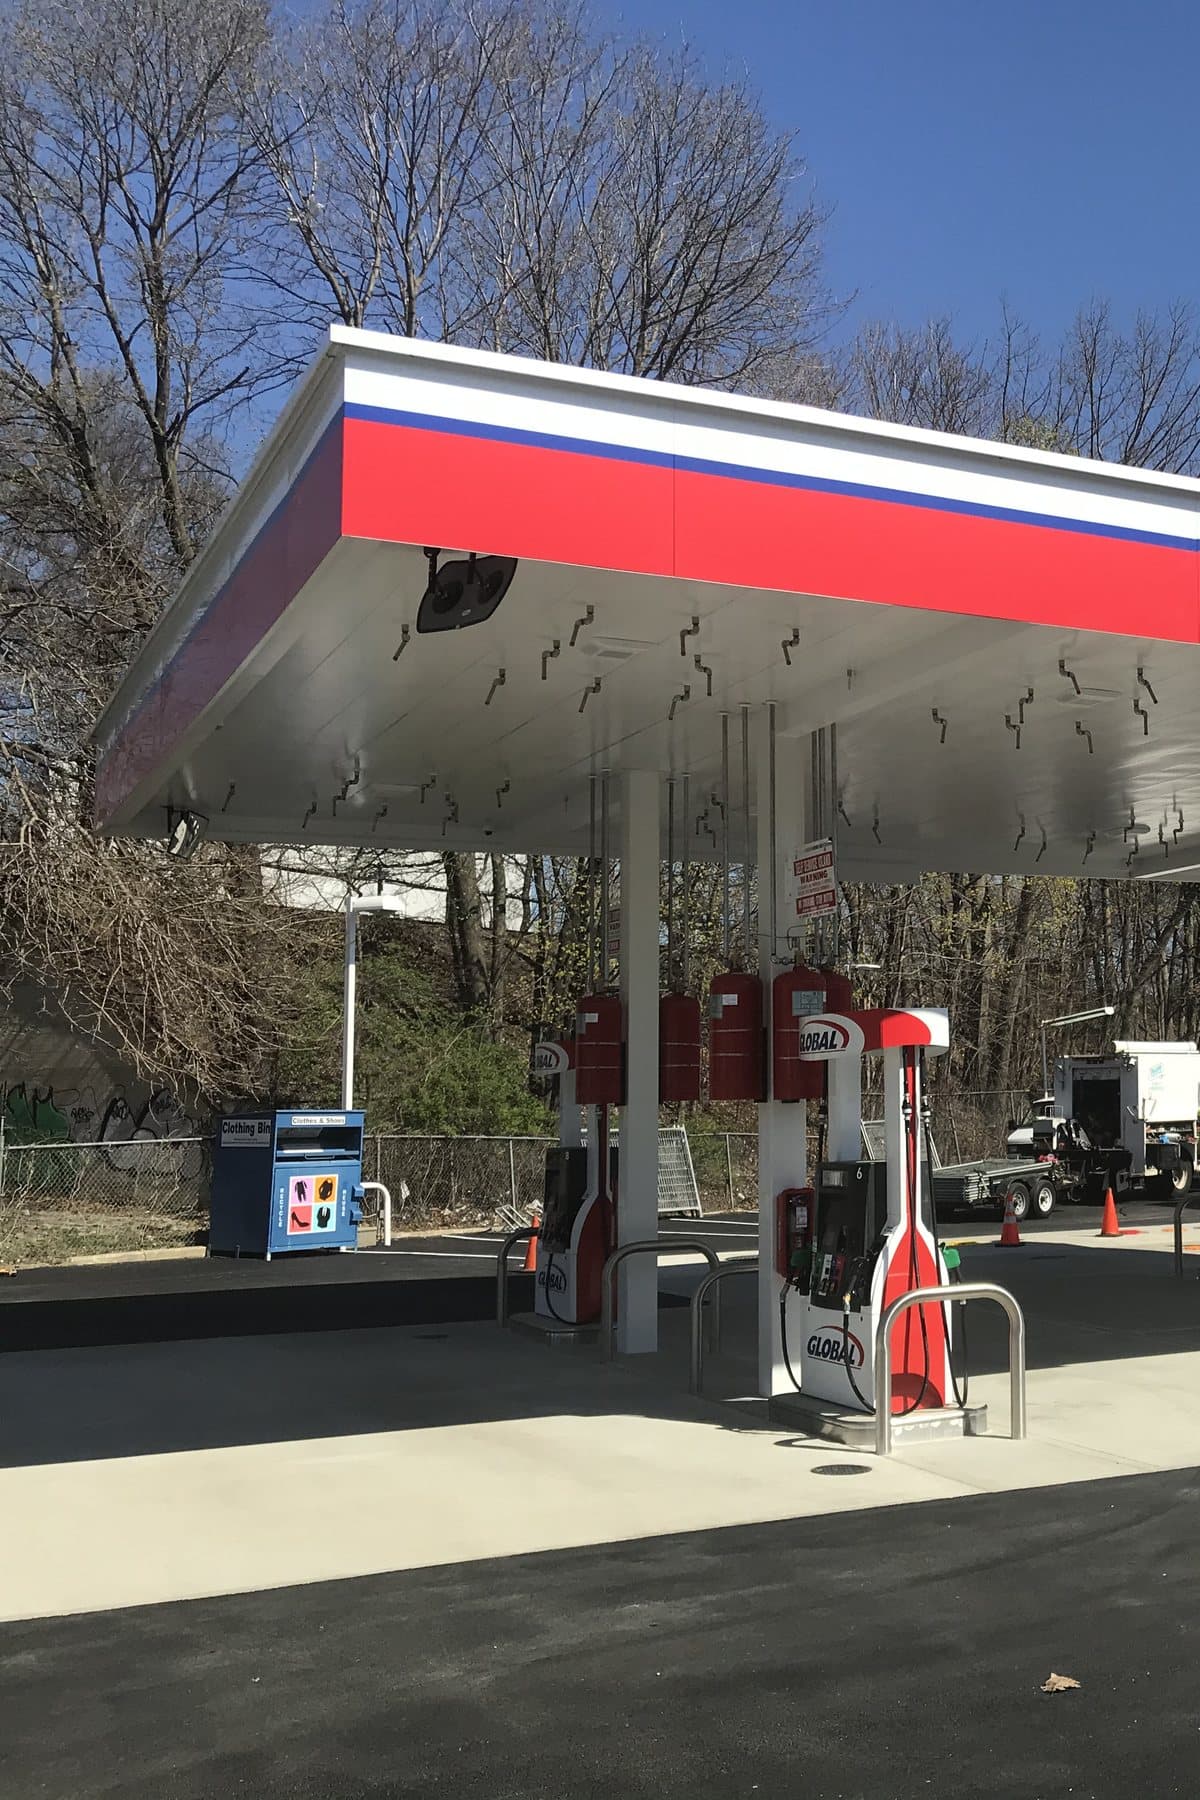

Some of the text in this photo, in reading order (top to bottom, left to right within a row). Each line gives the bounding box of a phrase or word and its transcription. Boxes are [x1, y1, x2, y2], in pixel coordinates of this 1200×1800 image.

[222, 1121, 271, 1136] Clothing Bin
[292, 1117, 317, 1125] Clothes
[325, 1117, 345, 1125] Shoes
[856, 1167, 863, 1180] 6
[538, 1271, 562, 1290] GLBAL
[807, 1335, 856, 1365] GLOBAL
